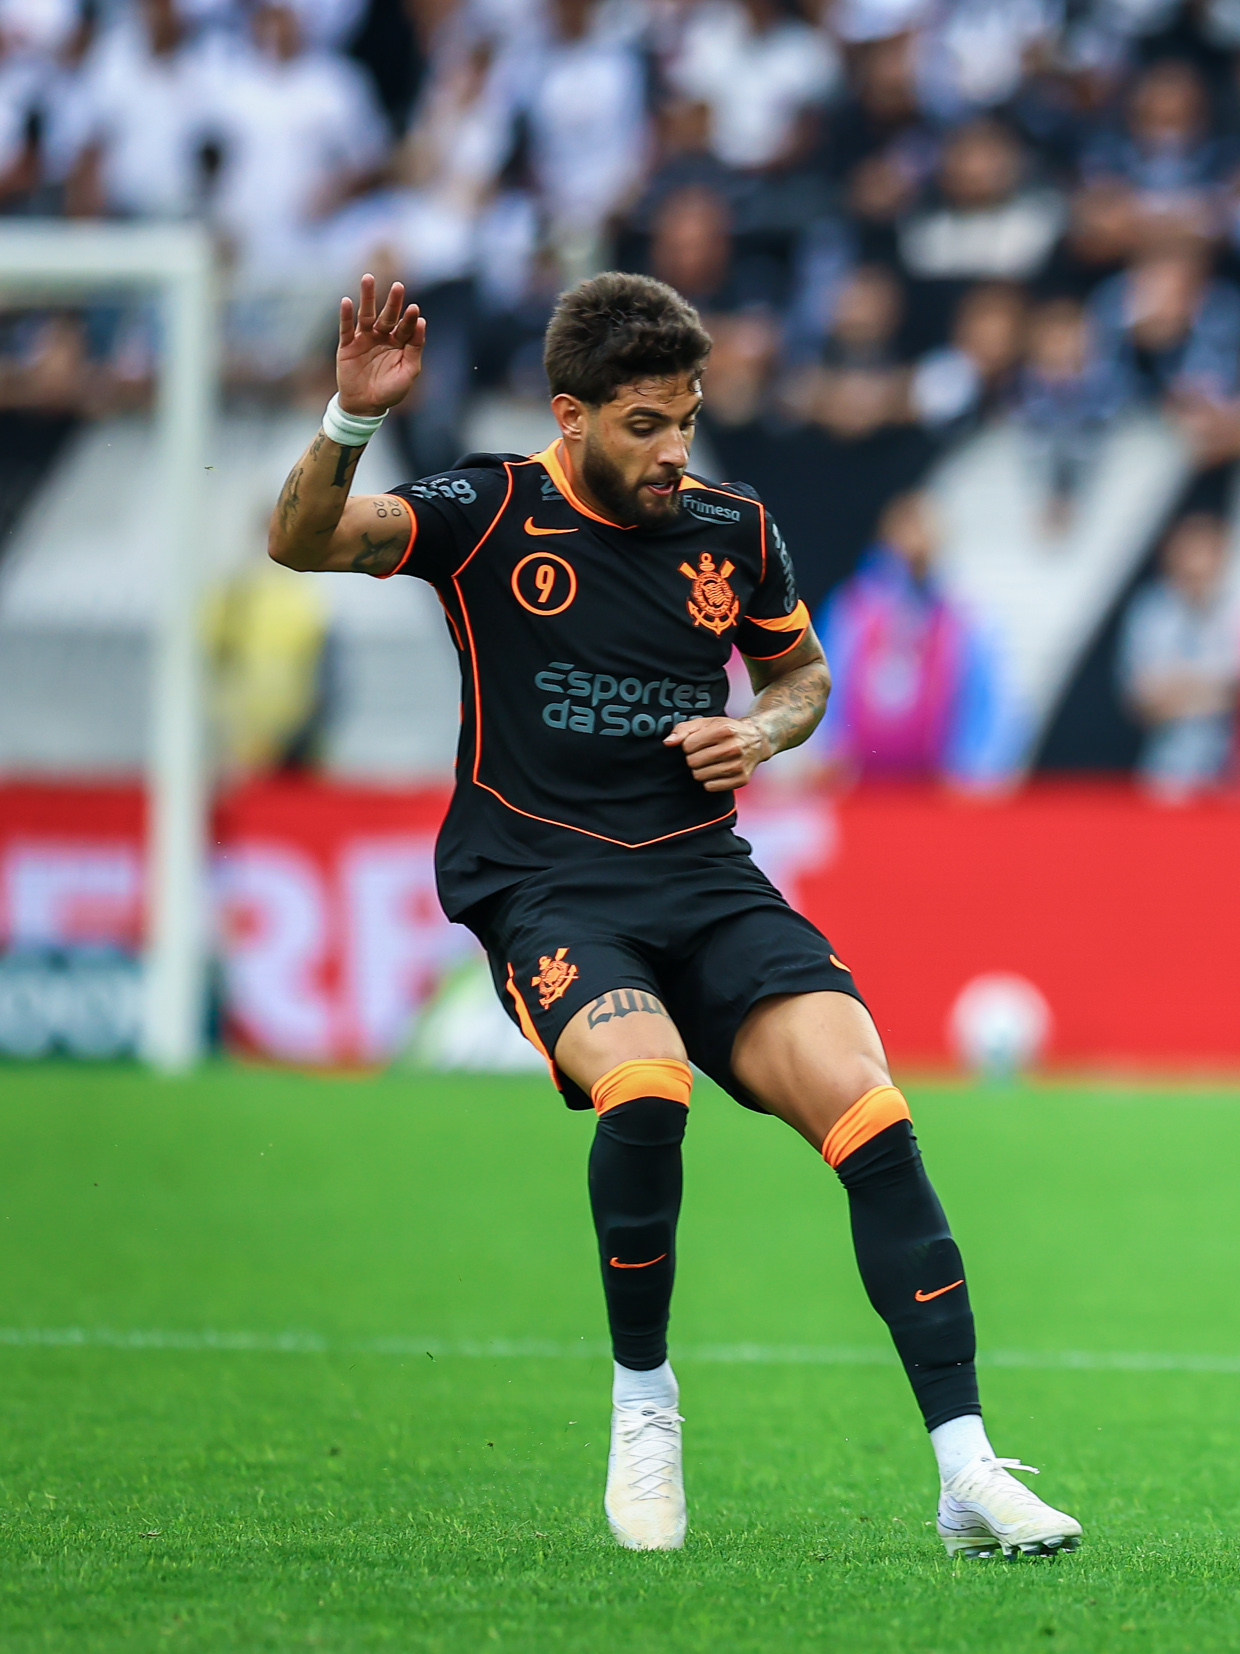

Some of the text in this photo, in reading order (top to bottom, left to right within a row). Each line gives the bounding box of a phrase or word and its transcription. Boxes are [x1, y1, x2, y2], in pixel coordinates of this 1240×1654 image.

[682, 495, 741, 522] Frimesa
[535, 564, 556, 603] 9
[534, 661, 712, 709] Esportes
[599, 704, 704, 737] Sort
